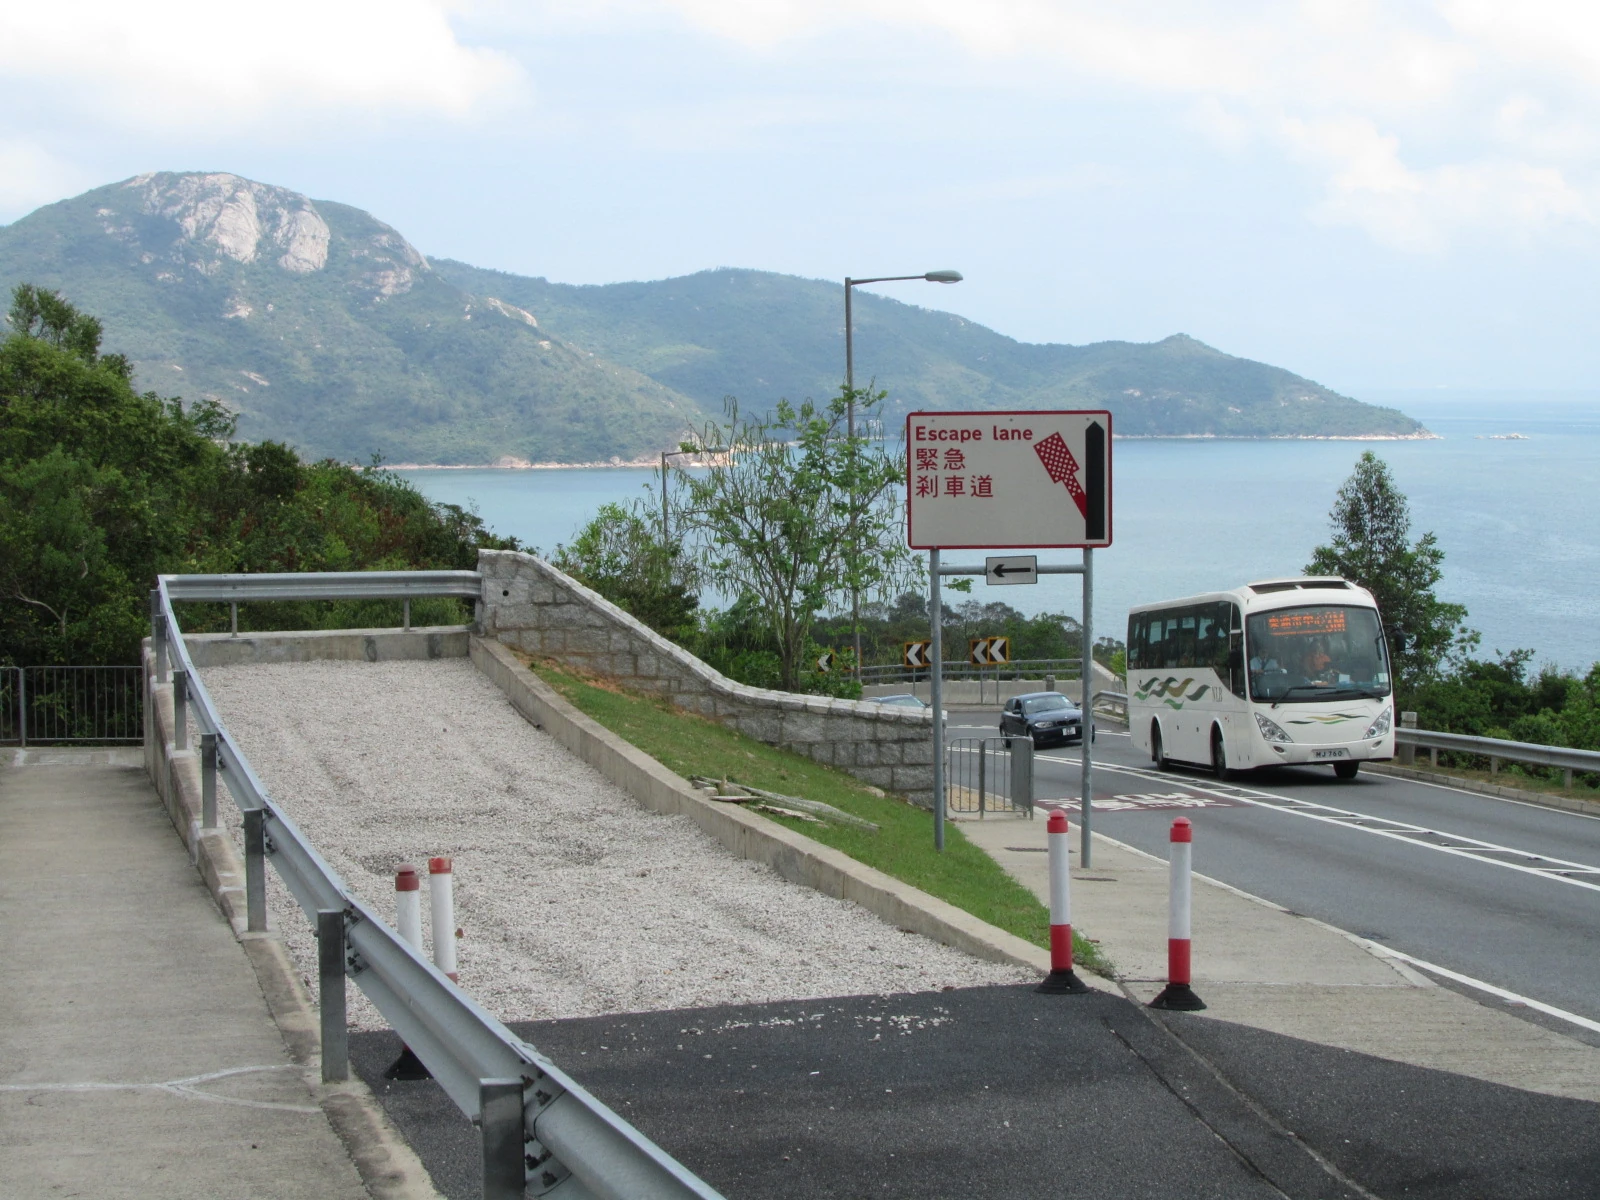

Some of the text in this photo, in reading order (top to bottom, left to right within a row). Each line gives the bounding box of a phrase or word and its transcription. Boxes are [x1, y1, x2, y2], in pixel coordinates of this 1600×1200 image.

[915, 425, 1033, 443] Escape lane
[916, 447, 966, 471] 緊急
[915, 474, 994, 499] 剎車道
